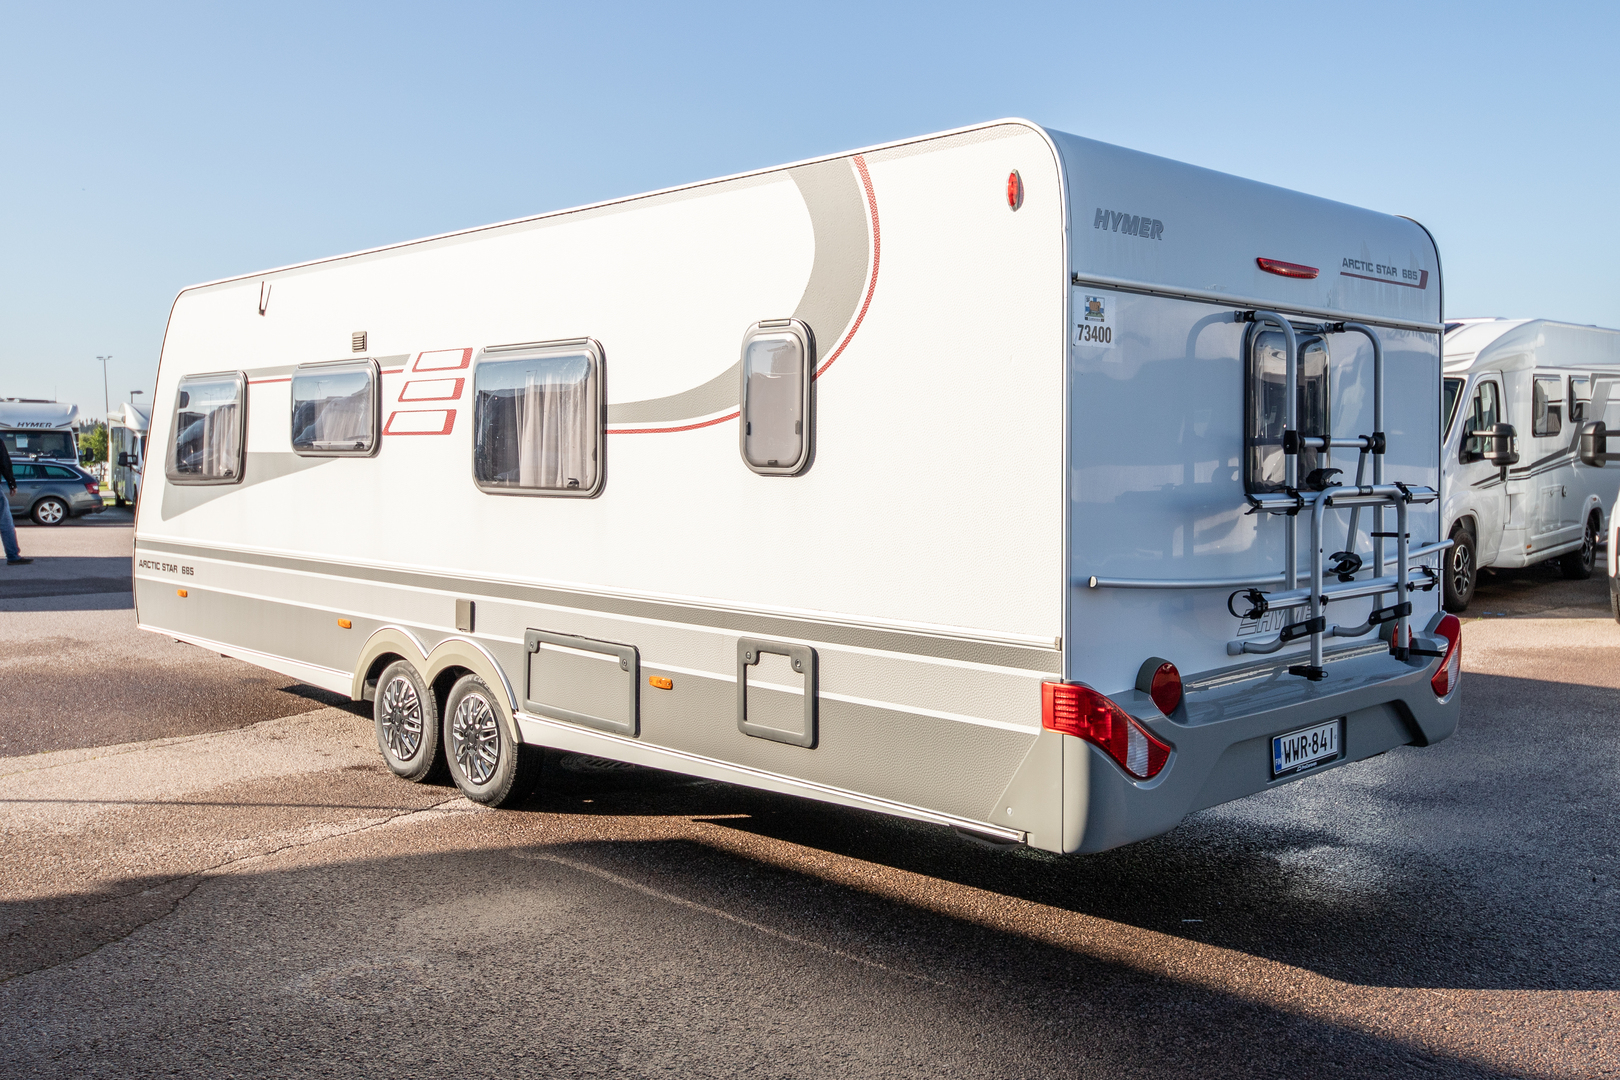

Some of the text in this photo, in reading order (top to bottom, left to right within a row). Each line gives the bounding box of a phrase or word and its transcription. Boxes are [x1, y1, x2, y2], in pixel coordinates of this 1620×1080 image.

[1094, 208, 1164, 240] HYMER
[1342, 257, 1418, 280] ARCTIC STAR 685
[1077, 324, 1111, 343] 73400
[138, 559, 194, 576] ARCTIC STAR 685
[1283, 727, 1333, 764] WWR-841
